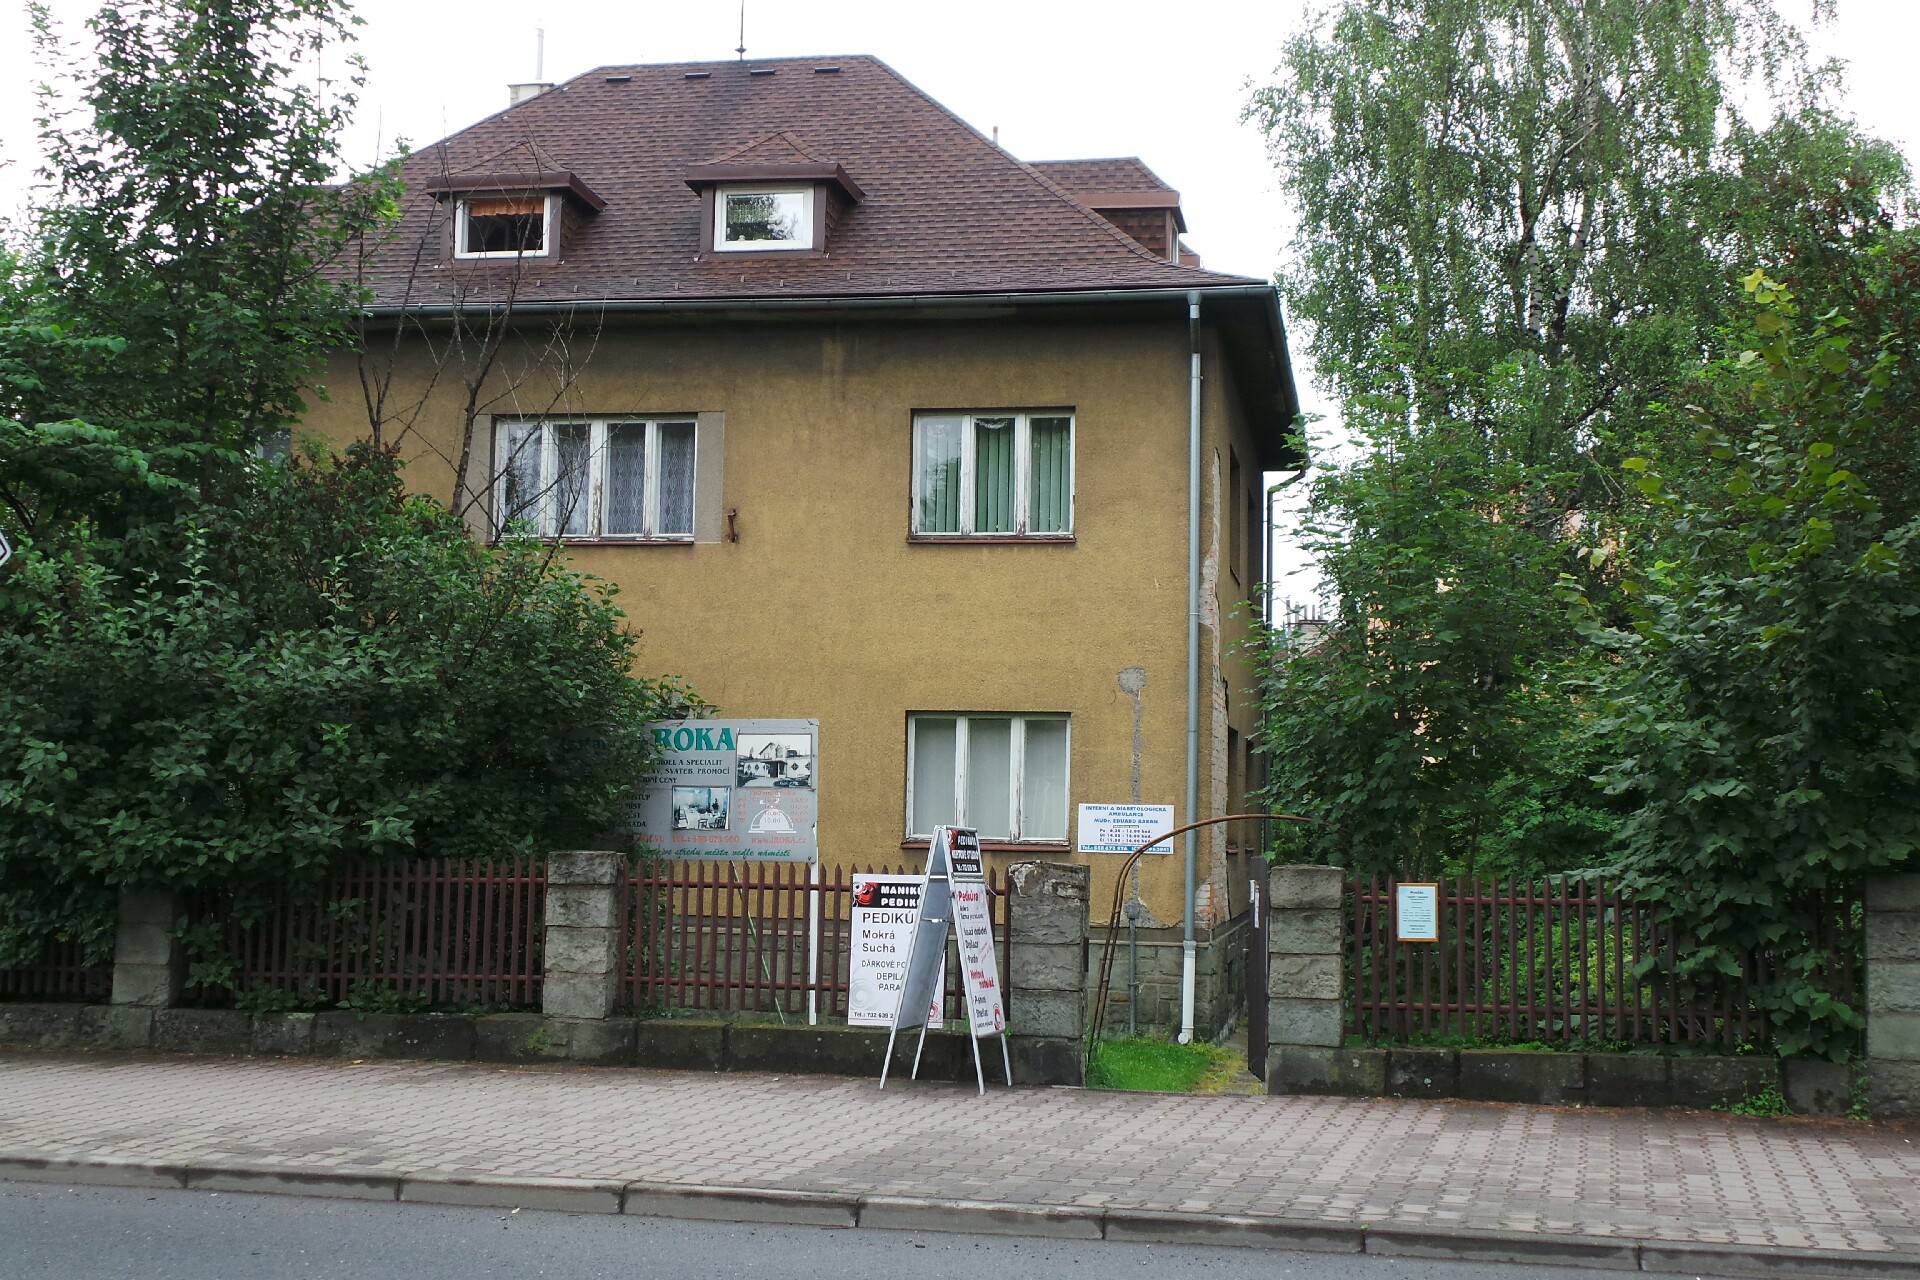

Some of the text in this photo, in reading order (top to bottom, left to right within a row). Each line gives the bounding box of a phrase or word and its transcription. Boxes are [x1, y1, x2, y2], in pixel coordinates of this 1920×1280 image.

[880, 897, 920, 907] PEDIK
[862, 909, 914, 924] PEDIKÚ
[862, 929, 895, 940] Mokrá
[862, 942, 896, 953] Suchá
[861, 958, 895, 969] DÁRKOVÉ
[878, 983, 901, 992] PARA
[853, 1011, 866, 1019] Tel.:
